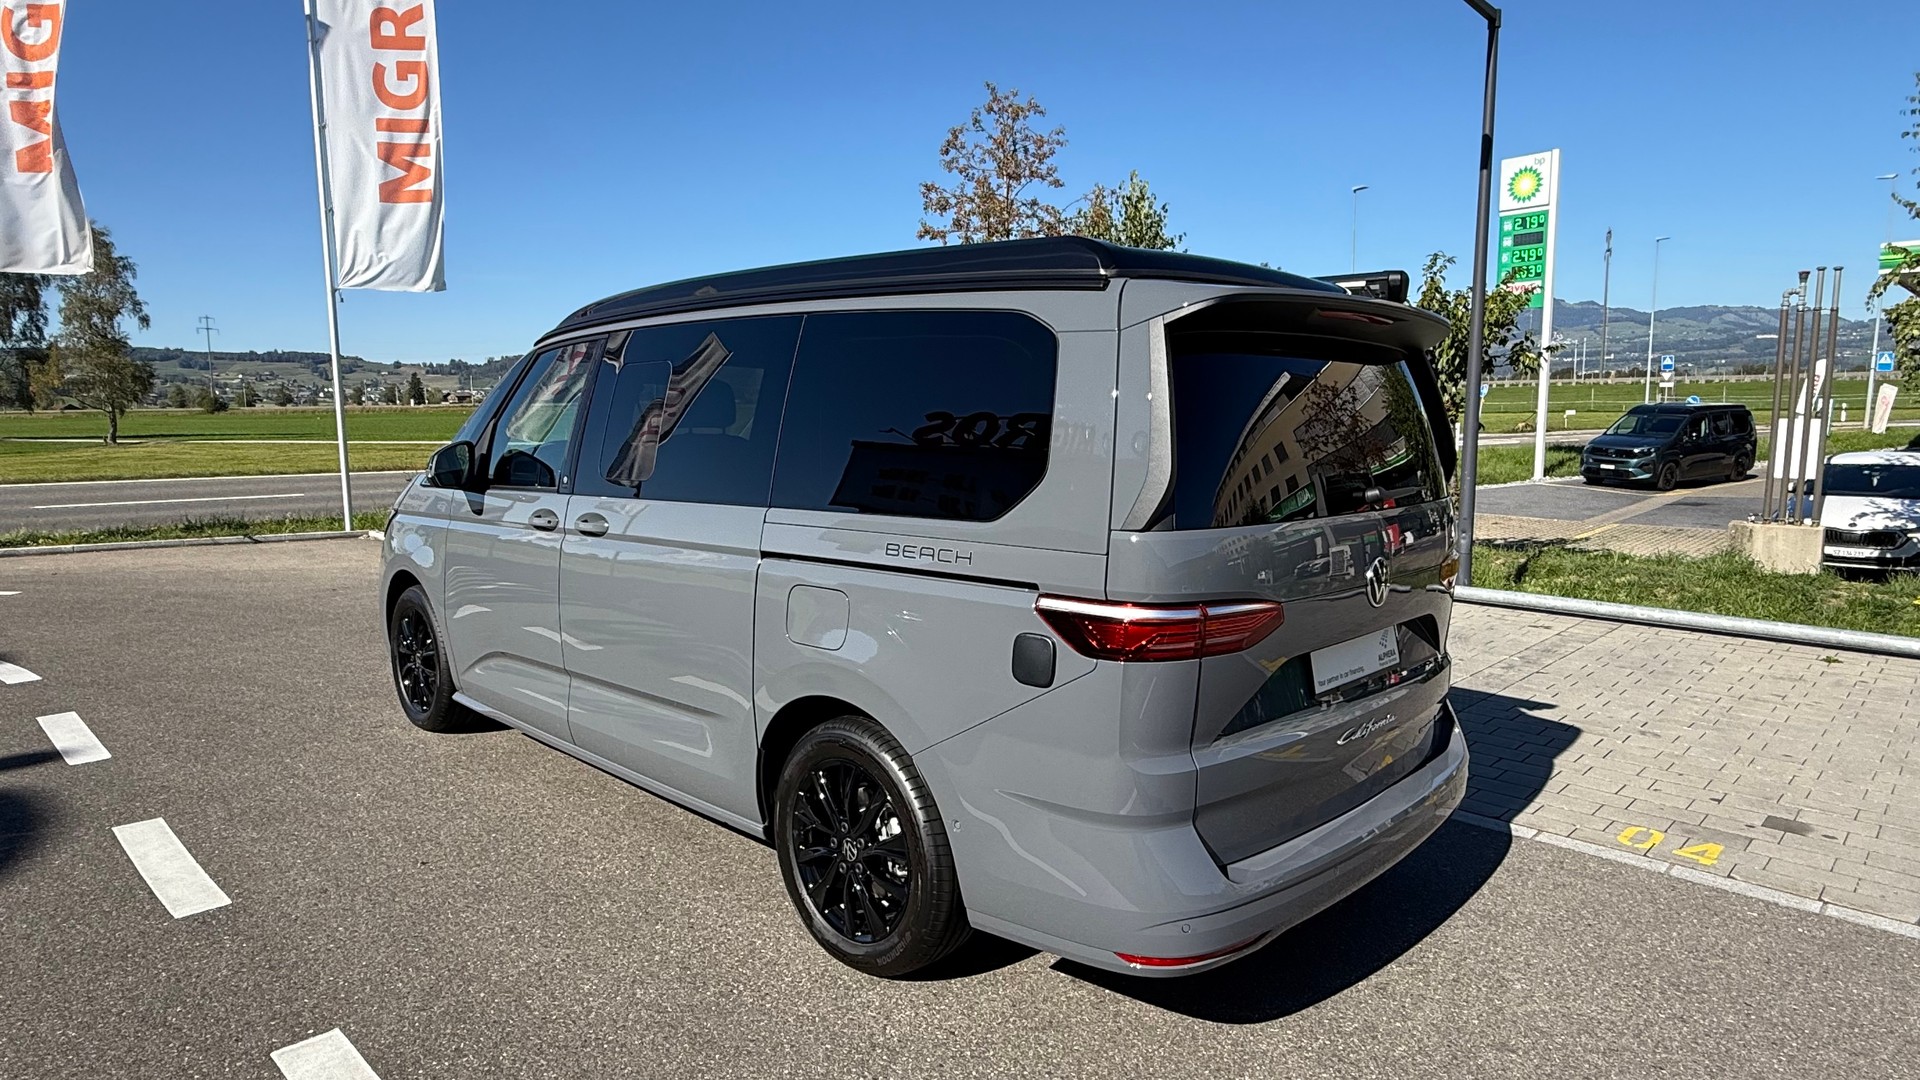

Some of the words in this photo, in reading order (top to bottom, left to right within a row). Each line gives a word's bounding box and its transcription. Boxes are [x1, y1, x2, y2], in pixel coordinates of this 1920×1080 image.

[369, 3, 432, 204] MIGR
[1534, 157, 1546, 166] bp
[885, 542, 973, 566] BEACH
[1336, 713, 1398, 746] California
